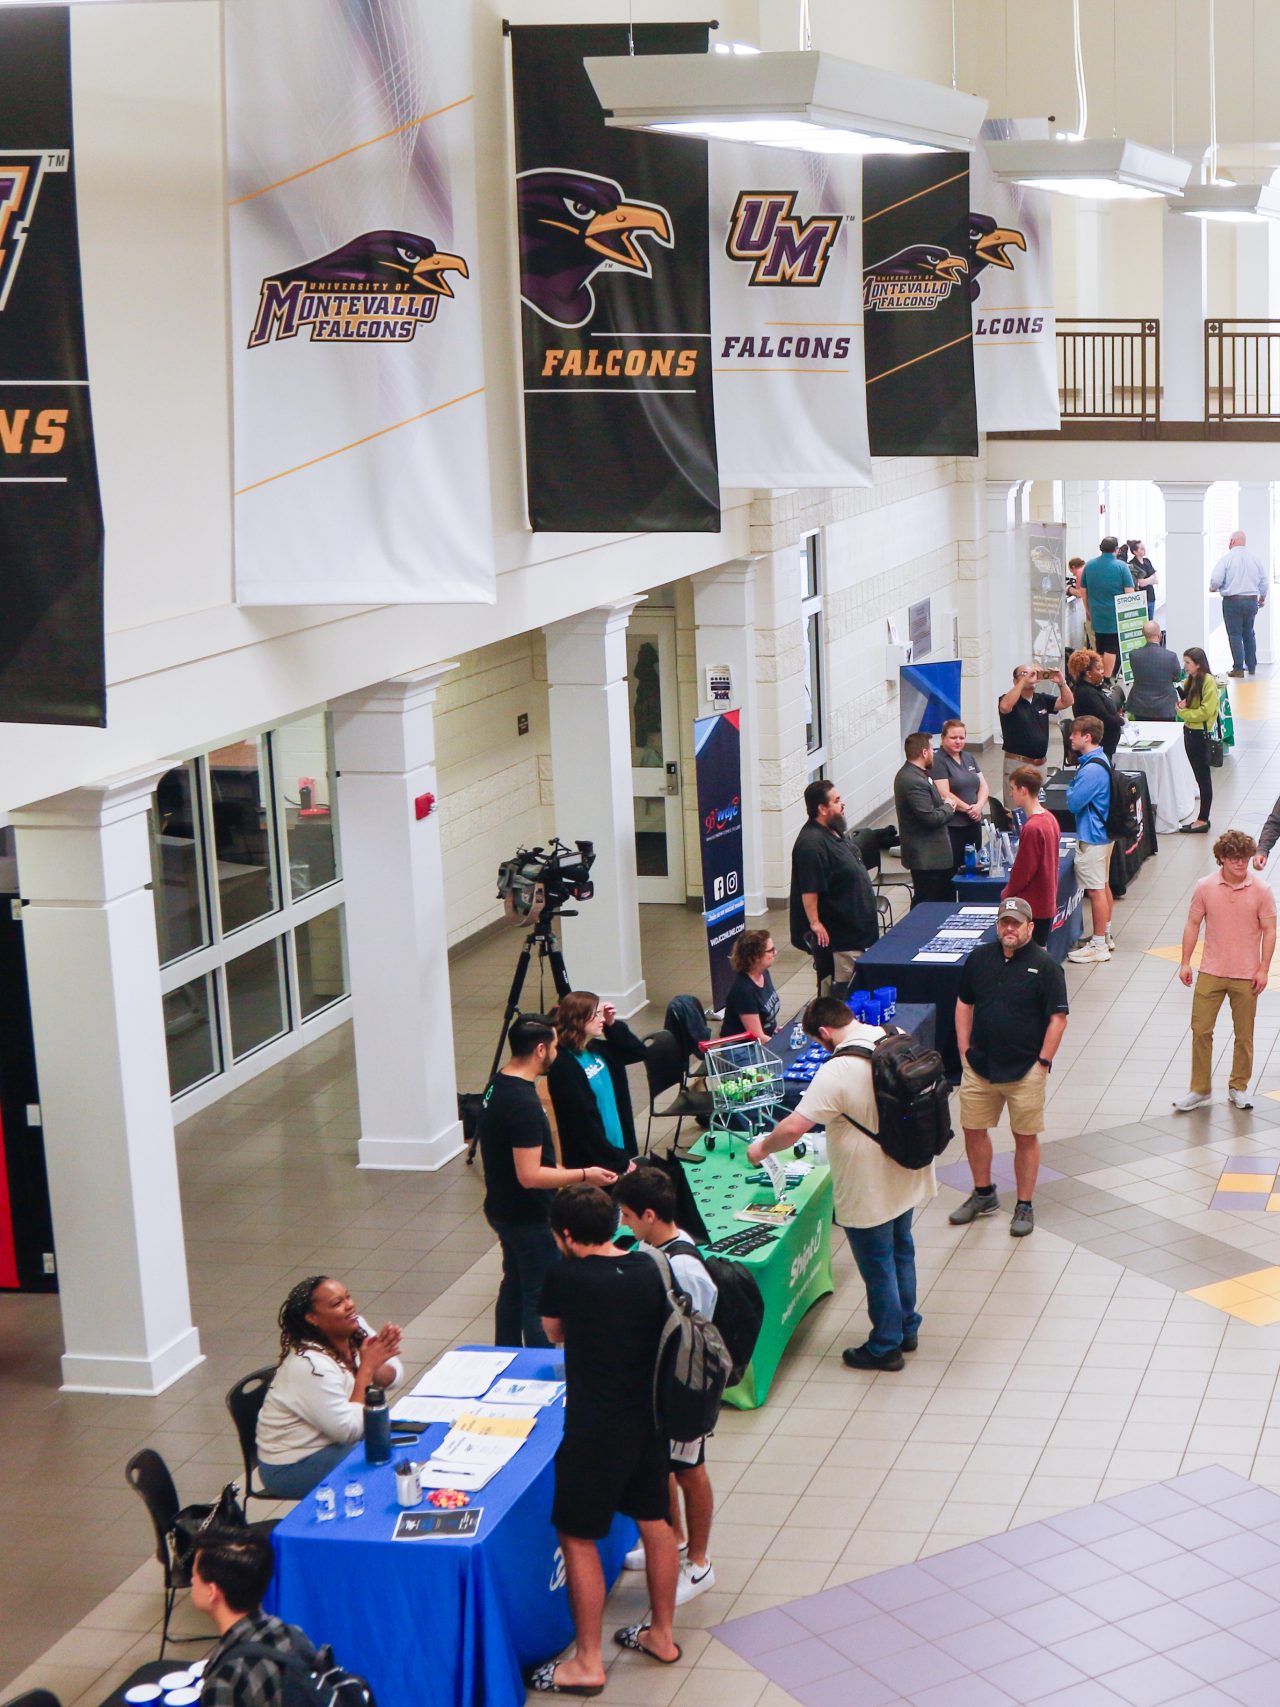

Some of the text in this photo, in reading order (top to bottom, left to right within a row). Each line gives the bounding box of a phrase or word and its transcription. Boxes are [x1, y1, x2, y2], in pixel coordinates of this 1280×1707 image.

[309, 282, 410, 291] UNIVERSITY OF
[880, 296, 935, 308] FALCONS
[254, 283, 436, 342] MONTEVALLO
[316, 320, 412, 338] FALCONS
[721, 336, 851, 359] FALCONS
[541, 349, 698, 377] FALCONS
[1117, 594, 1141, 605] STRONG
